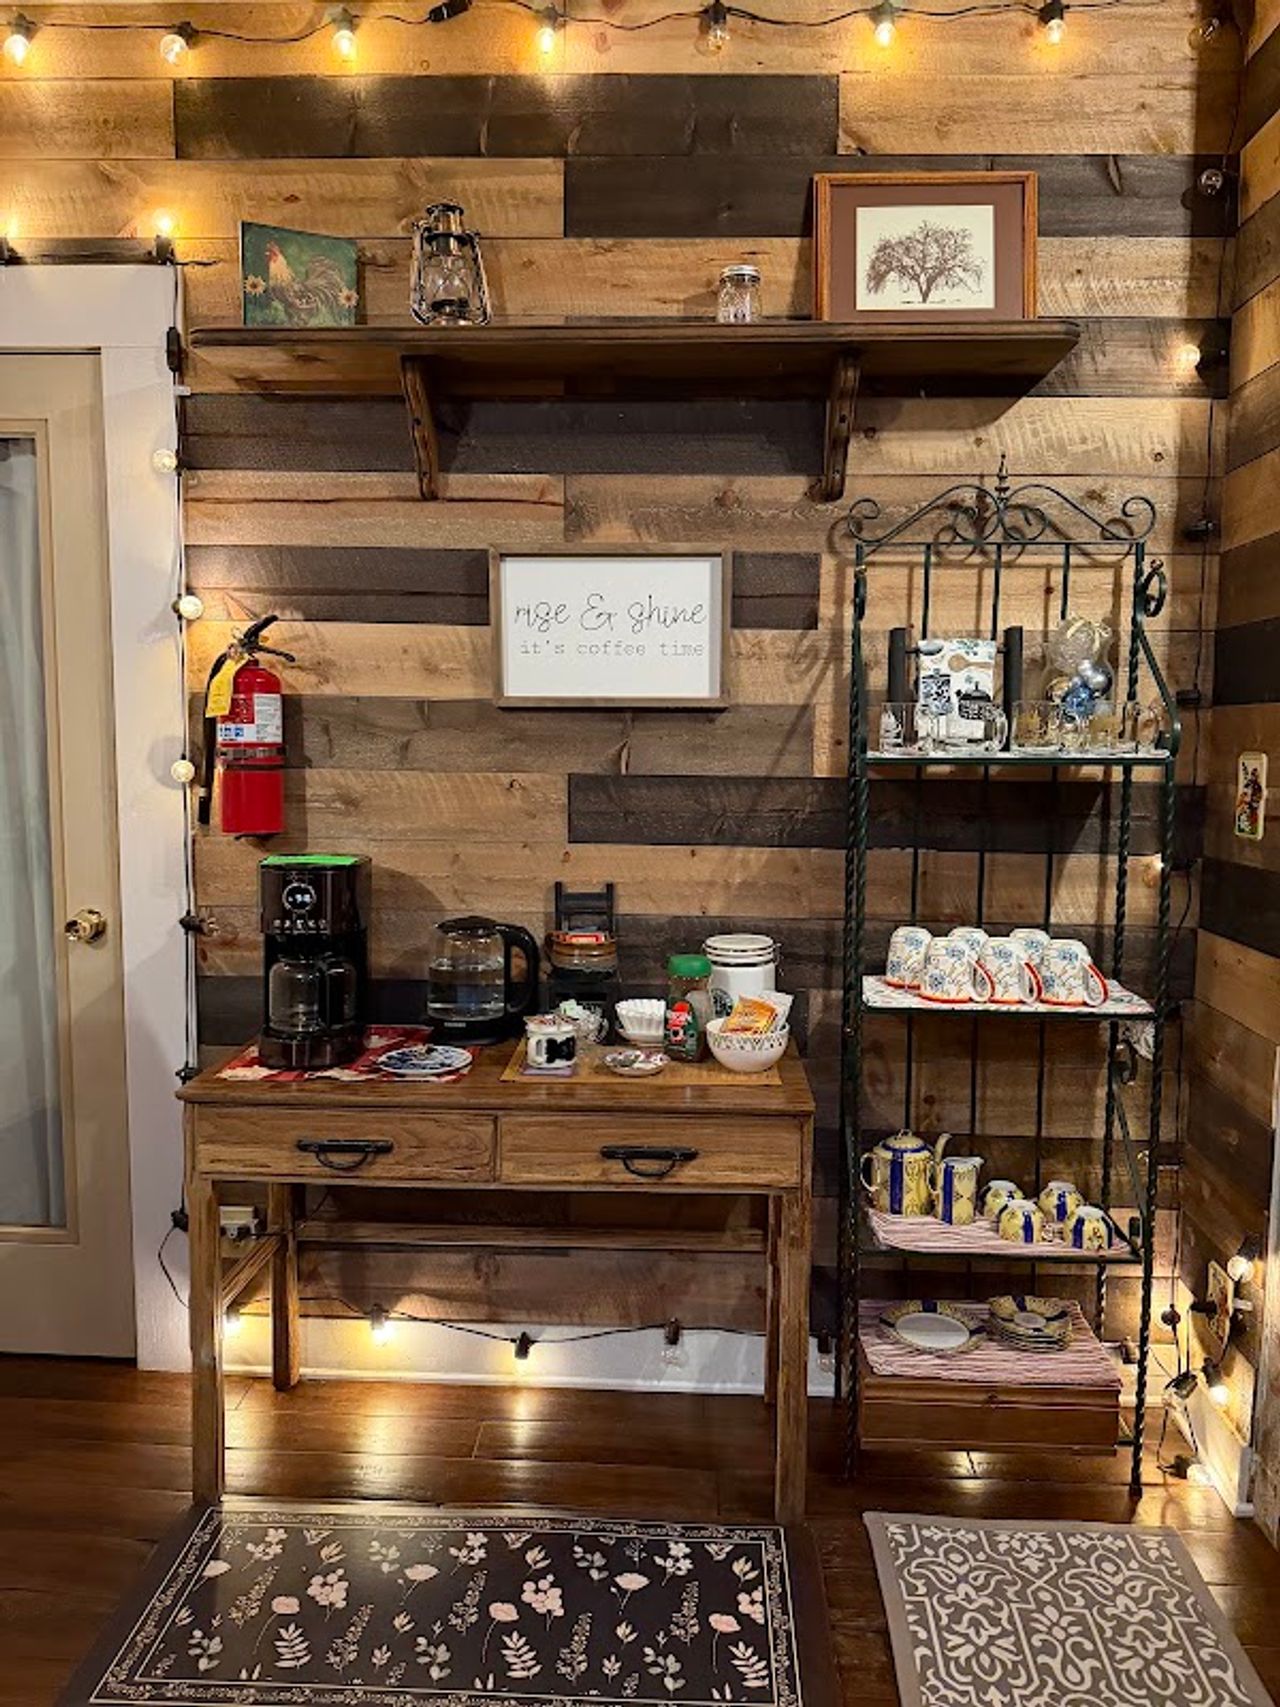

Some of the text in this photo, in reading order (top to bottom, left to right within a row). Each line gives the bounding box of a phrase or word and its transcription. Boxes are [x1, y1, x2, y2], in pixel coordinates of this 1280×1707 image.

[514, 593, 708, 634] rise & shine
[520, 640, 705, 656] it's coffee time
